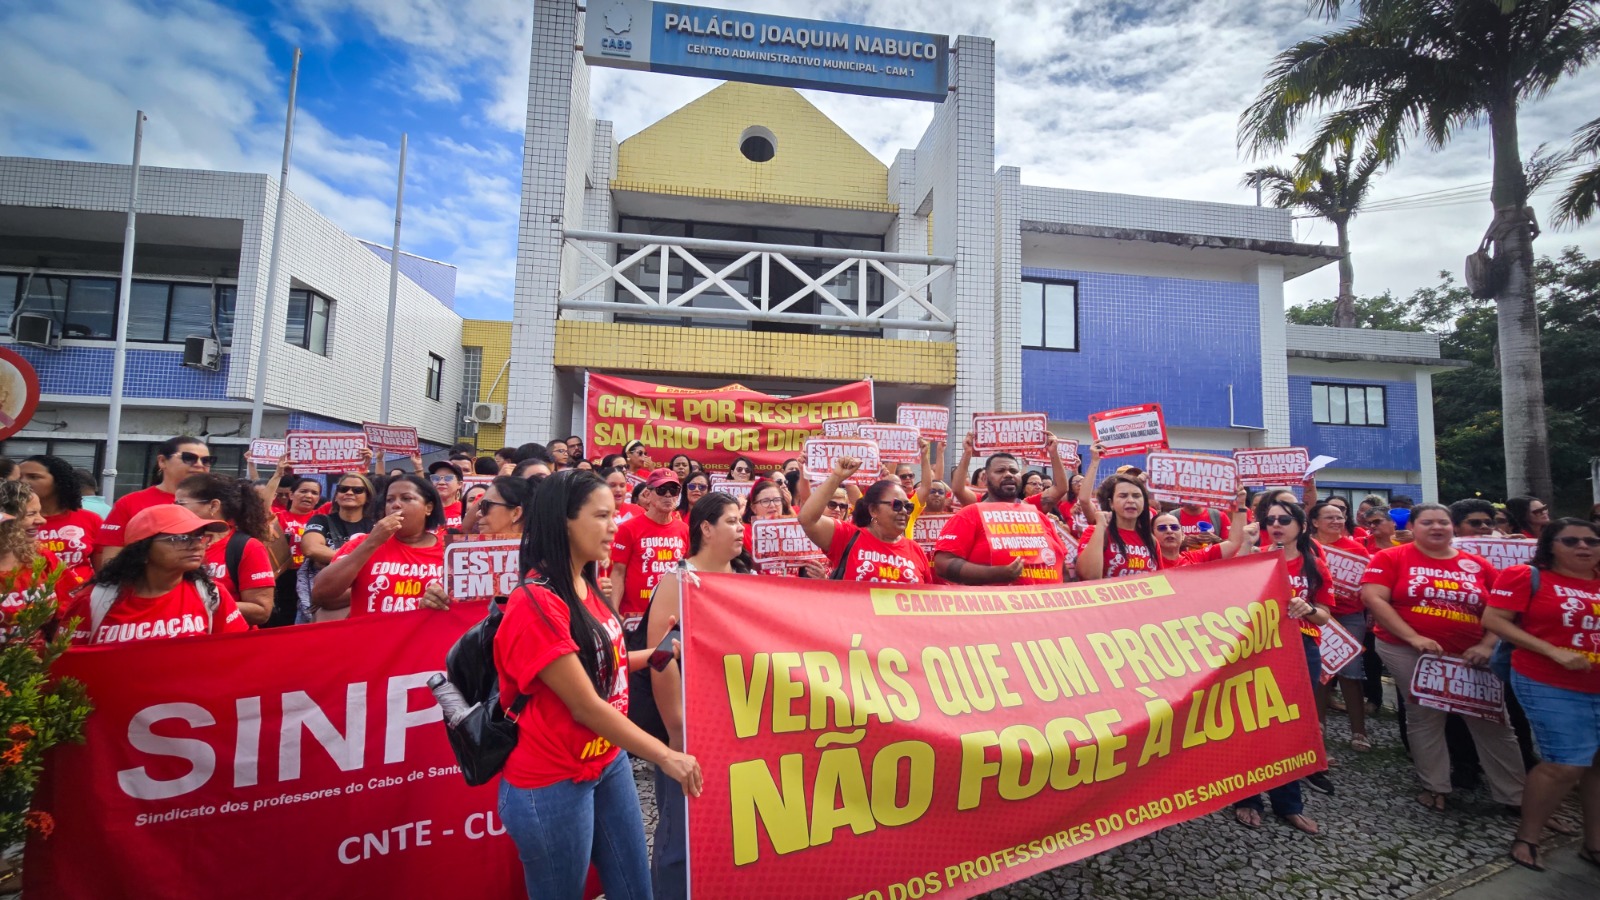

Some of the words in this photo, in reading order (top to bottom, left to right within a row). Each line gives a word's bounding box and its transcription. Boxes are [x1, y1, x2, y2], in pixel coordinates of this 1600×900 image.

[601, 38, 632, 50] CABO
[664, 13, 756, 39] PALÁCIO
[760, 25, 849, 51] JOAQUIM
[855, 35, 937, 60] NABUCO
[687, 43, 730, 57] CENTRO
[731, 48, 821, 67] ADMINISTRATIVO
[822, 57, 878, 74] MUNICIPAL
[885, 66, 908, 77] CAM
[909, 68, 915, 77] 1
[598, 394, 678, 421] GREVE
[683, 397, 737, 424] POR
[743, 401, 860, 425] RESPEITO
[900, 409, 948, 421] ESTAMOS
[916, 420, 948, 431] GREVE!
[977, 419, 1044, 434] ESTAMOS
[367, 427, 415, 440] ESTAMOS
[368, 434, 383, 445] EM
[384, 436, 416, 447] GREVE!
[594, 420, 703, 449] SALÁRIO
[706, 427, 760, 452] POR
[860, 428, 918, 441] ESTAMOS
[977, 432, 997, 444] EM
[999, 429, 1044, 443] GREVE!
[291, 438, 364, 450] ESTAMOS
[808, 444, 878, 459] ESTAMOS
[879, 439, 918, 451] GREVE!
[252, 448, 268, 456] EM
[290, 448, 313, 460] EM
[1238, 452, 1305, 466] ESTAMOS
[807, 457, 829, 469] EM
[1152, 457, 1235, 480] ESTAMOS
[1238, 465, 1257, 475] EM
[1260, 462, 1306, 475] GREVE!
[1151, 471, 1176, 486] EM
[1178, 473, 1235, 493] GREVE!
[982, 510, 1040, 523] PREFEITO
[986, 523, 1045, 534] VALORIZE
[640, 536, 684, 549] EDUCAÇÃO
[757, 538, 780, 554] EM
[990, 537, 1003, 549] OS
[1002, 536, 1049, 549] PROFESSORES
[453, 550, 520, 575] ESTA
[657, 549, 673, 561] NÃO
[858, 549, 916, 570] EDUCAÇÃO
[641, 560, 649, 573] É
[1128, 557, 1145, 569] NÃO
[647, 574, 655, 588] É
[879, 566, 900, 581] NÃO
[1409, 566, 1477, 583] EDUCAÇÃO
[394, 578, 422, 596] NÃO
[453, 574, 494, 598] EM
[1408, 584, 1417, 598] É
[1433, 579, 1459, 590] NÃO
[367, 593, 377, 613] É
[895, 593, 1009, 613] CAMPANHA
[1010, 588, 1097, 611] SALARIAL
[1098, 580, 1154, 603] SINPC
[1410, 605, 1480, 625] INVESTIMENTO
[1562, 611, 1575, 627] É
[98, 614, 205, 644] EDUCAÇÃO
[723, 634, 922, 740] VERÁS
[921, 642, 1023, 718] QUE
[1023, 632, 1098, 704] UM
[1097, 598, 1284, 690] PROFESSOR
[1420, 658, 1502, 689] ESTAMOS
[1417, 672, 1445, 692] EM
[1449, 679, 1502, 704] GREVE!
[116, 670, 448, 801] SINP
[729, 727, 937, 868] NÃO
[957, 708, 1130, 813] FOGE
[1138, 682, 1176, 767] À
[1181, 665, 1301, 752] LUTA.
[134, 805, 216, 828] Sindicato
[218, 799, 250, 815] dos
[252, 784, 342, 809] professores
[344, 781, 365, 795] do
[366, 774, 404, 792] Cabo
[406, 768, 425, 783] de
[888, 871, 942, 900] DOS
[944, 825, 1096, 888] PROFESSORES
[1095, 813, 1124, 837] DO
[1125, 797, 1174, 827] CABO
[1173, 789, 1198, 811] DE
[1197, 773, 1246, 804] SANTO
[1246, 749, 1318, 787] AGOSTINHO
[338, 818, 432, 865] CNTE
[464, 811, 507, 840] CU
